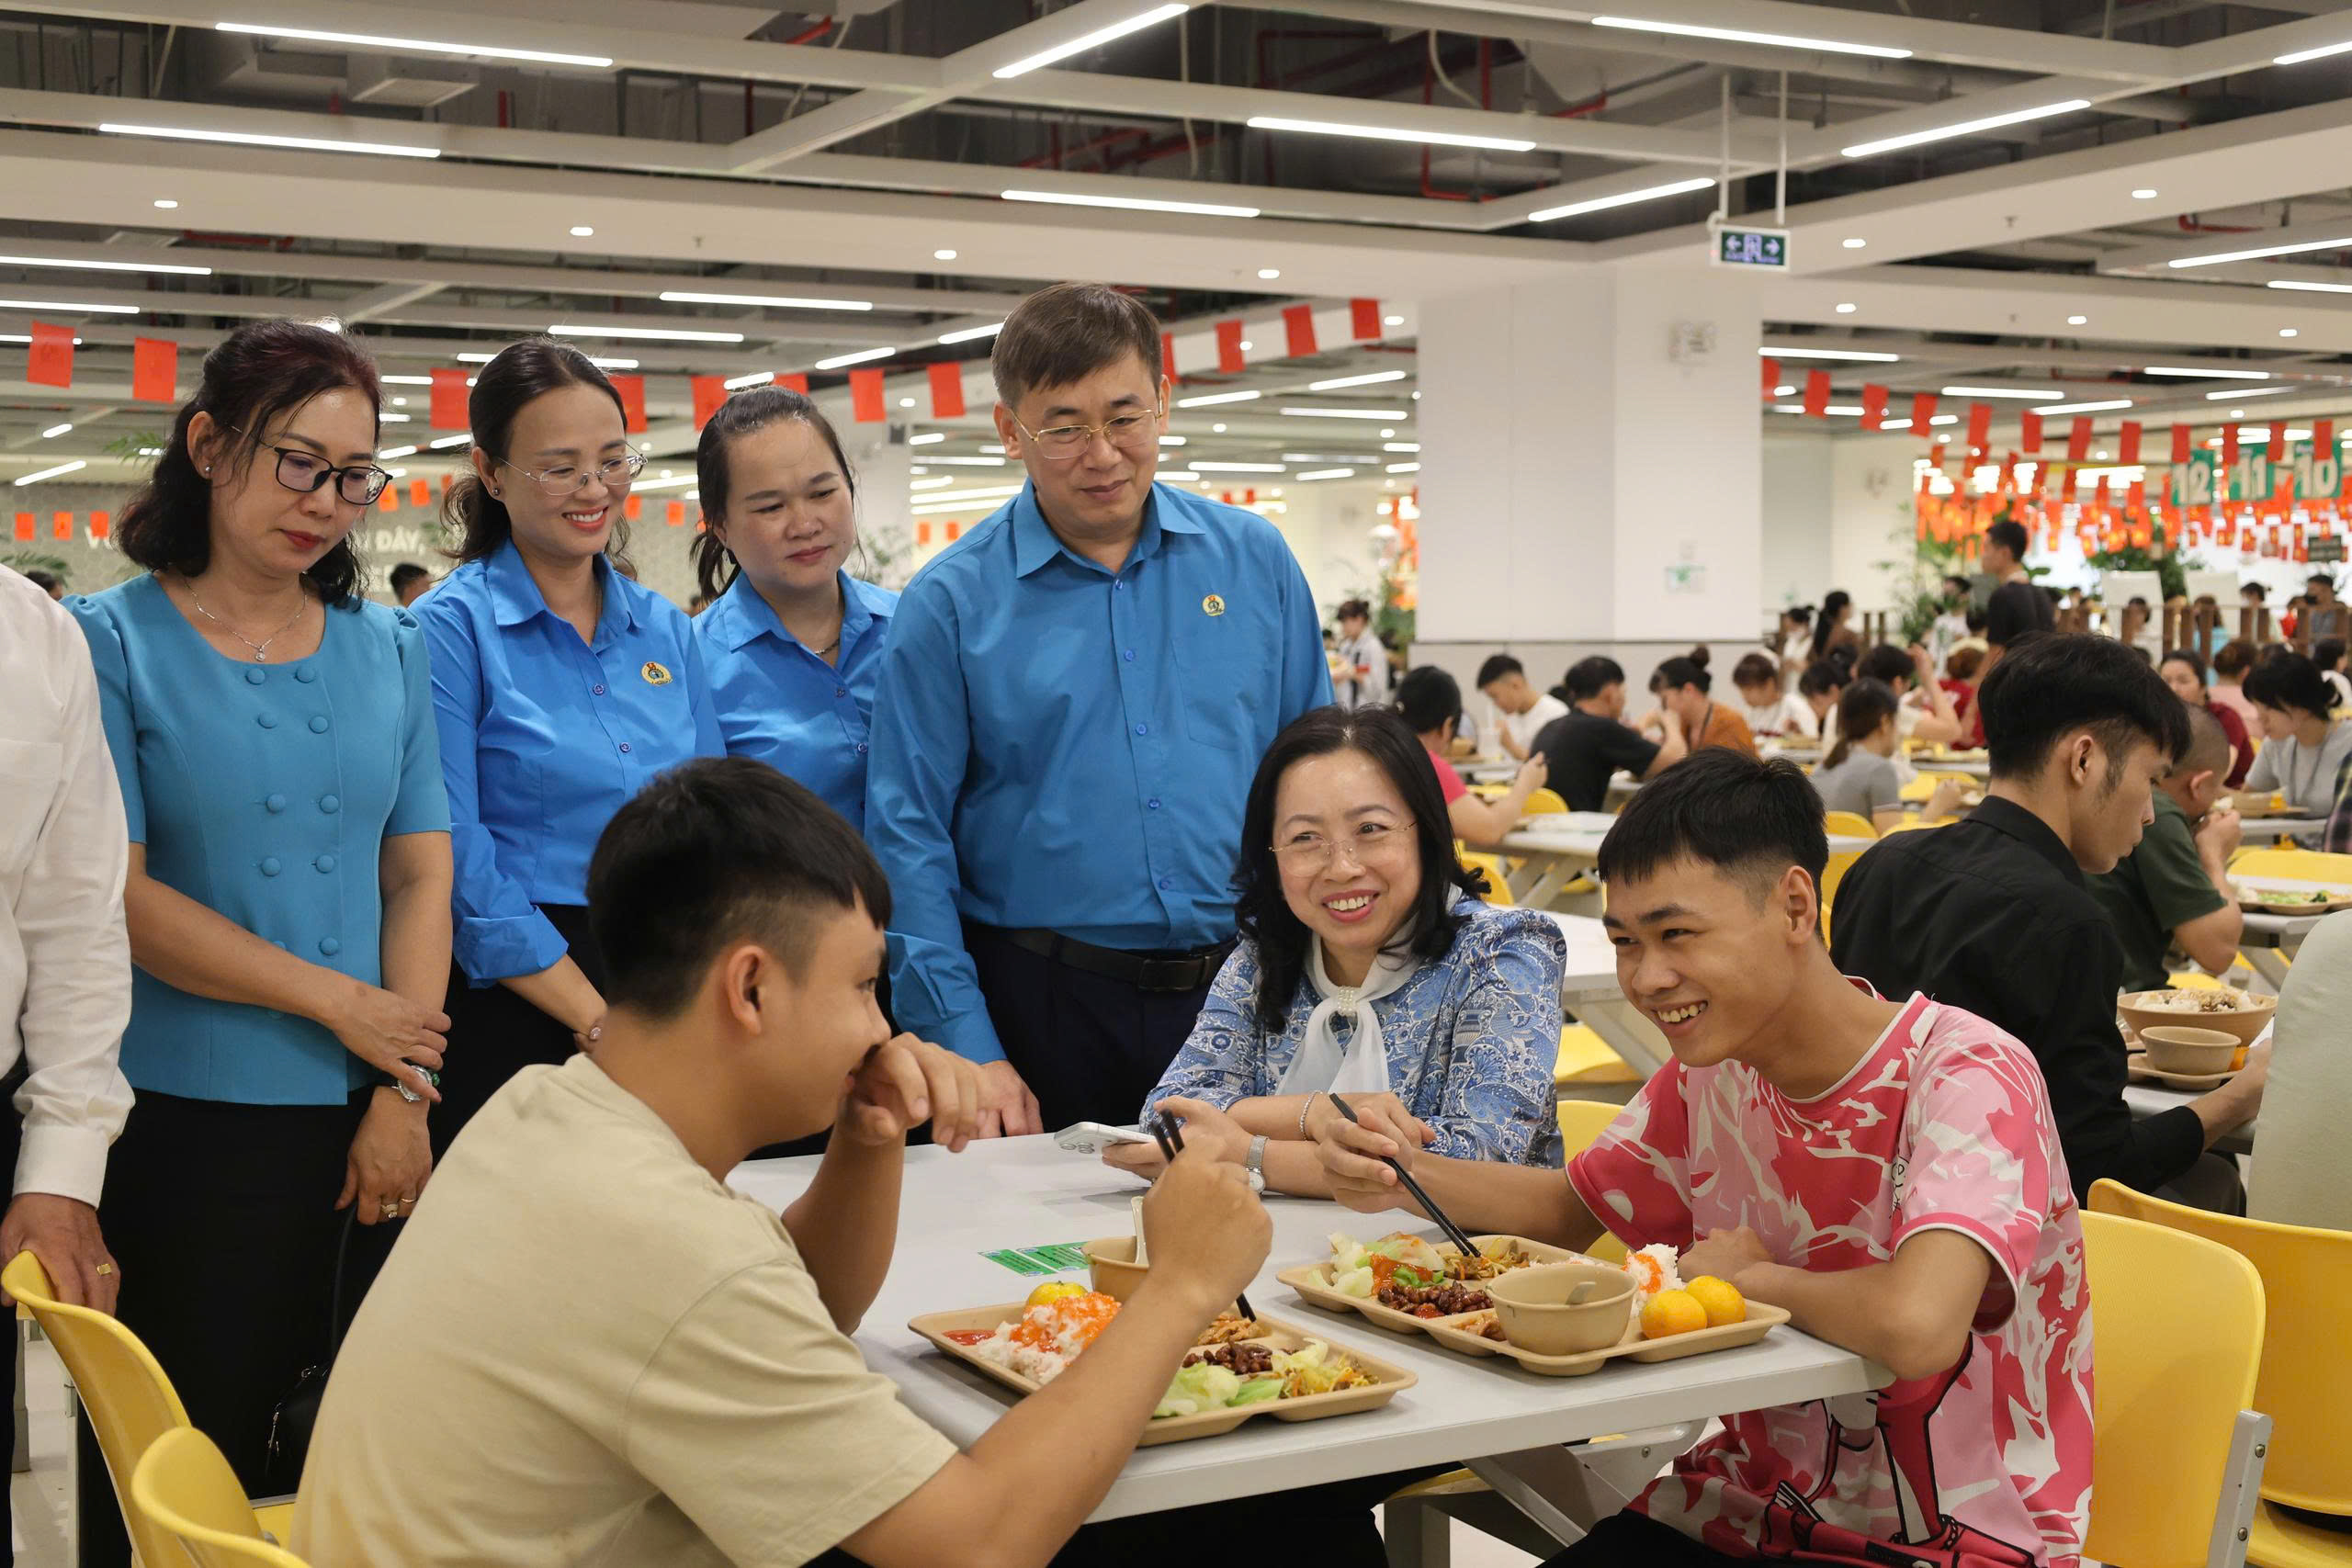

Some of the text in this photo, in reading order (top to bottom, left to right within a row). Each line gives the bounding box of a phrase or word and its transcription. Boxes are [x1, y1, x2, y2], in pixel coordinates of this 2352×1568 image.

[2172, 461, 2212, 504] 12
[2229, 455, 2267, 500] 11
[2294, 453, 2339, 498] 10
